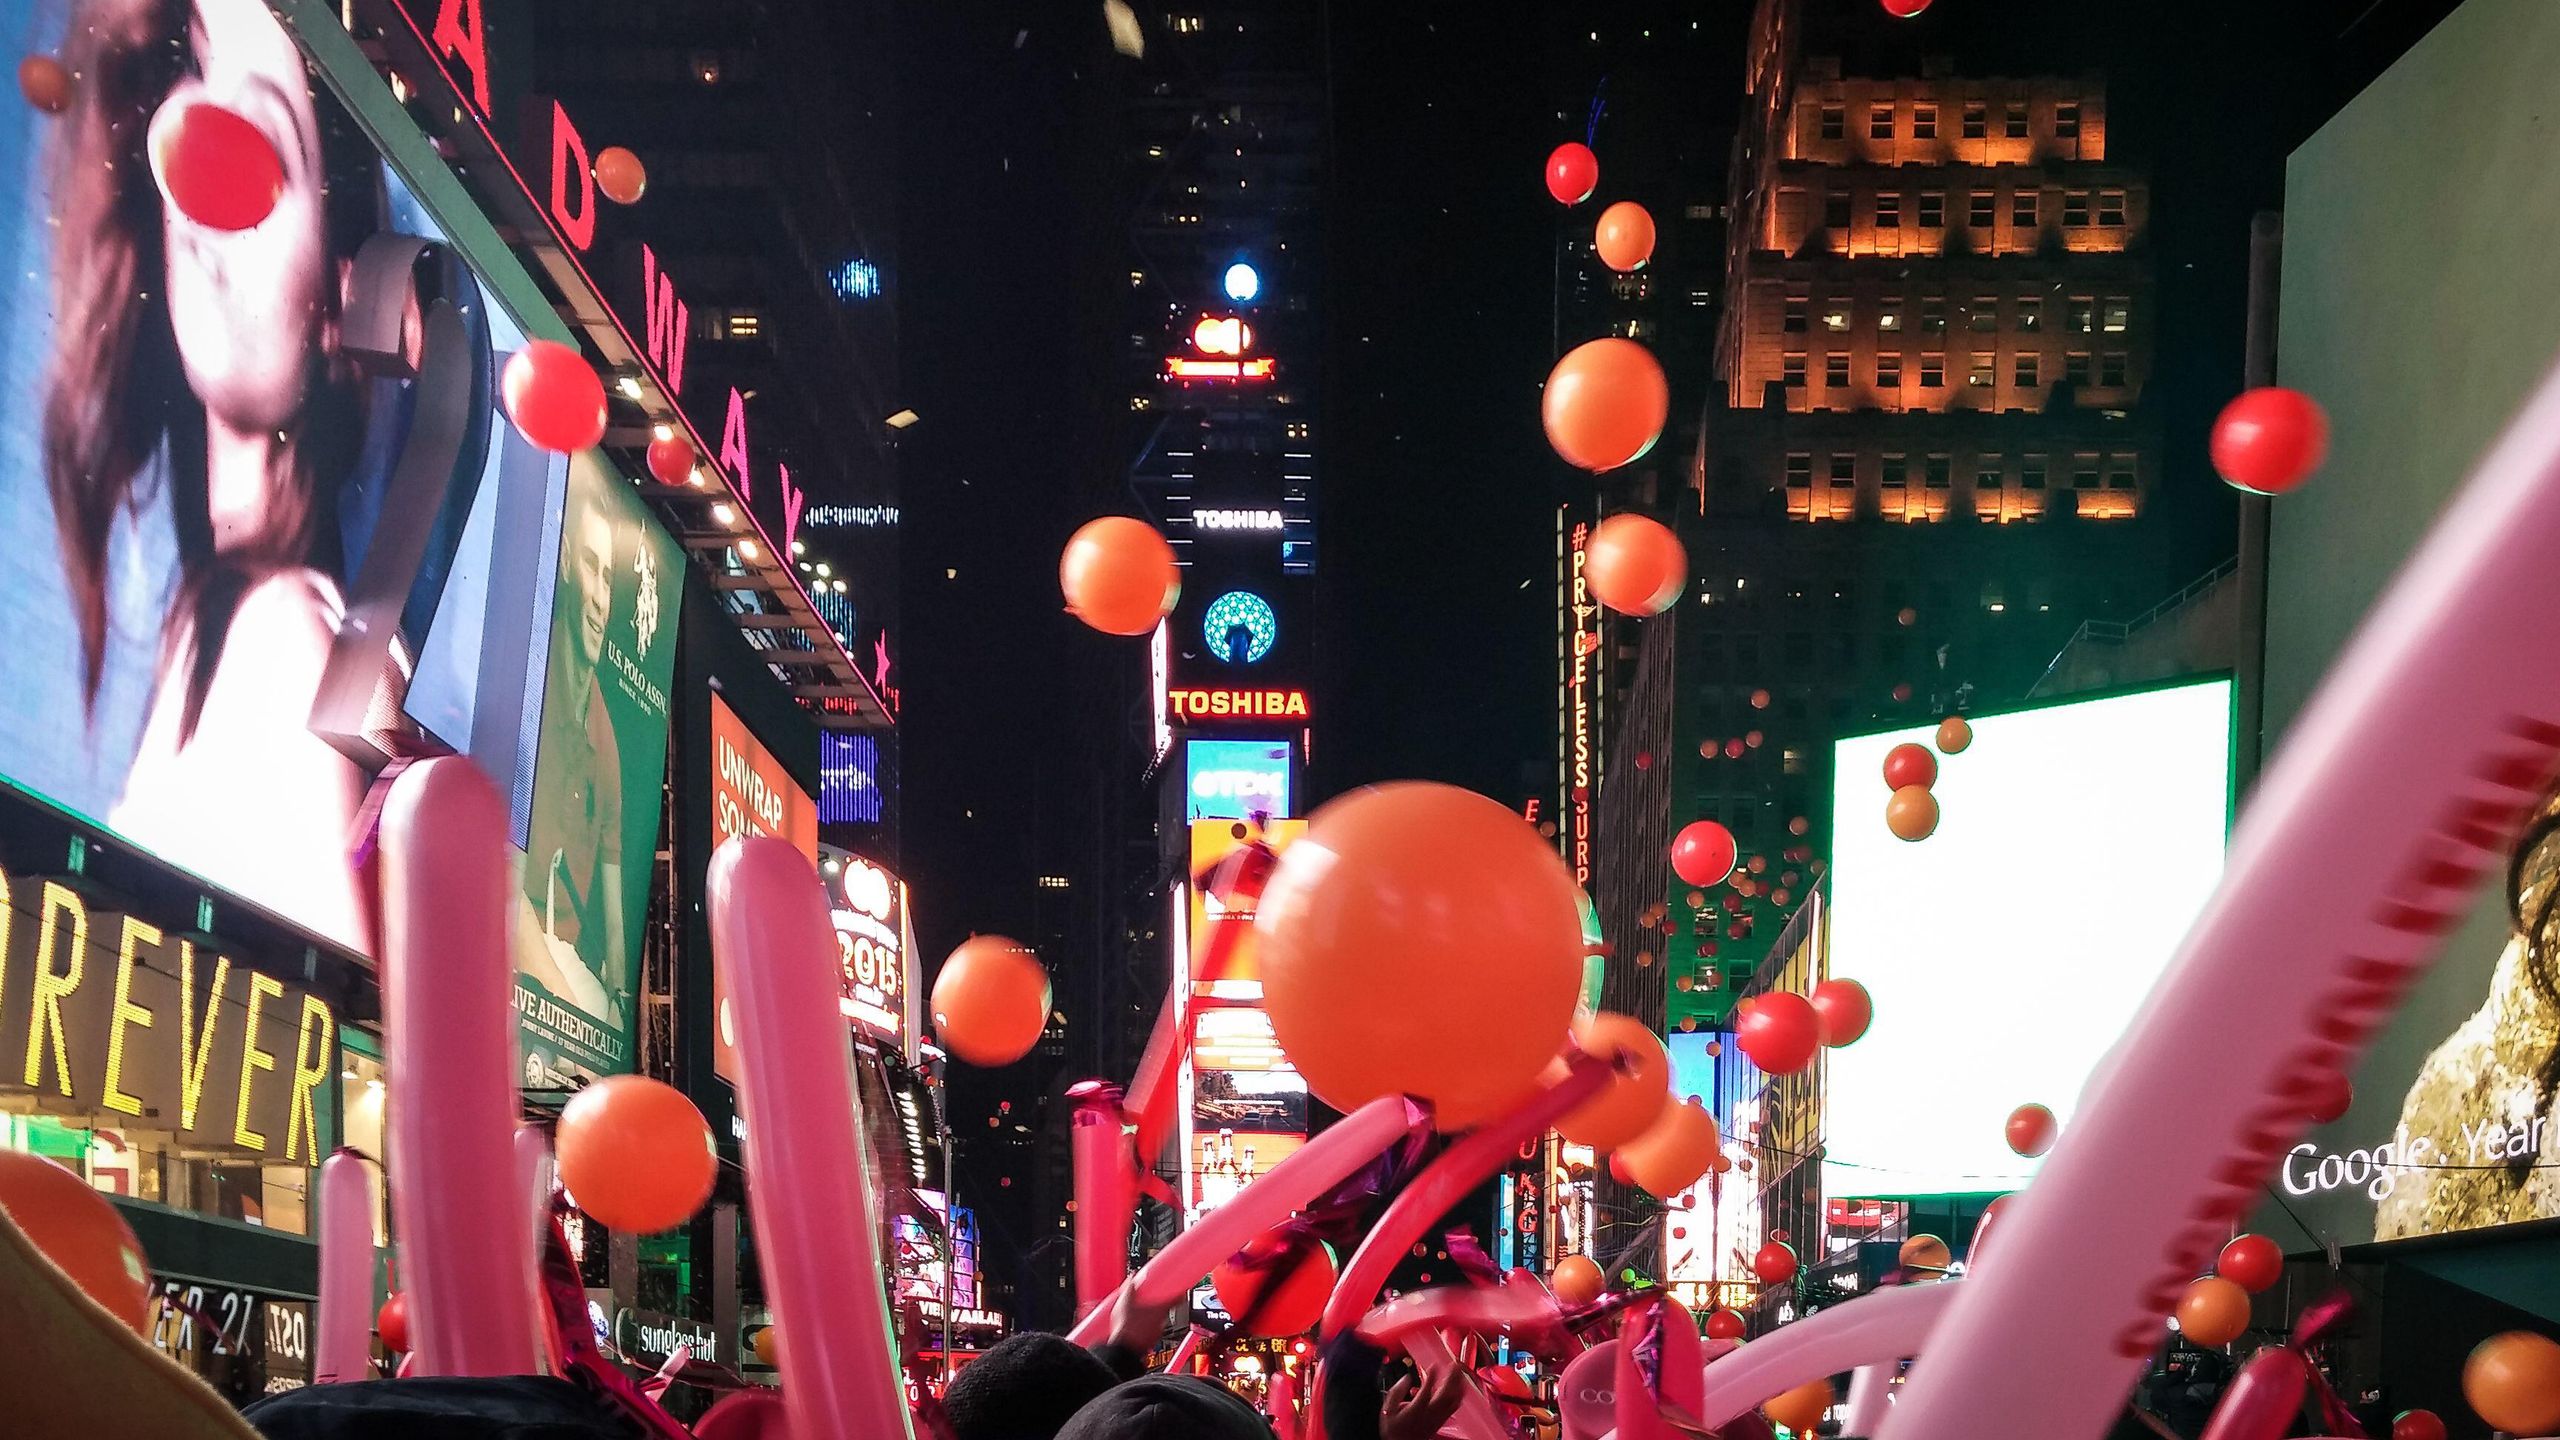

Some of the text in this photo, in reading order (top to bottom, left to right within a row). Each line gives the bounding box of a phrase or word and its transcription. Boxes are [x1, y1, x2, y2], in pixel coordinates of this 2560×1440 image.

[1193, 510, 1283, 529] TOSHIBA
[623, 656, 646, 692] POLO
[1169, 690, 1307, 715] TOSHIBA
[719, 734, 783, 832] UNWRAP
[510, 984, 624, 1062] IVE AUTHENTICALLY
[2282, 1116, 2547, 1201] Google Year
[148, 1282, 254, 1356] ER 21
[641, 1320, 695, 1359] sunglass
[696, 1325, 717, 1363] hut
